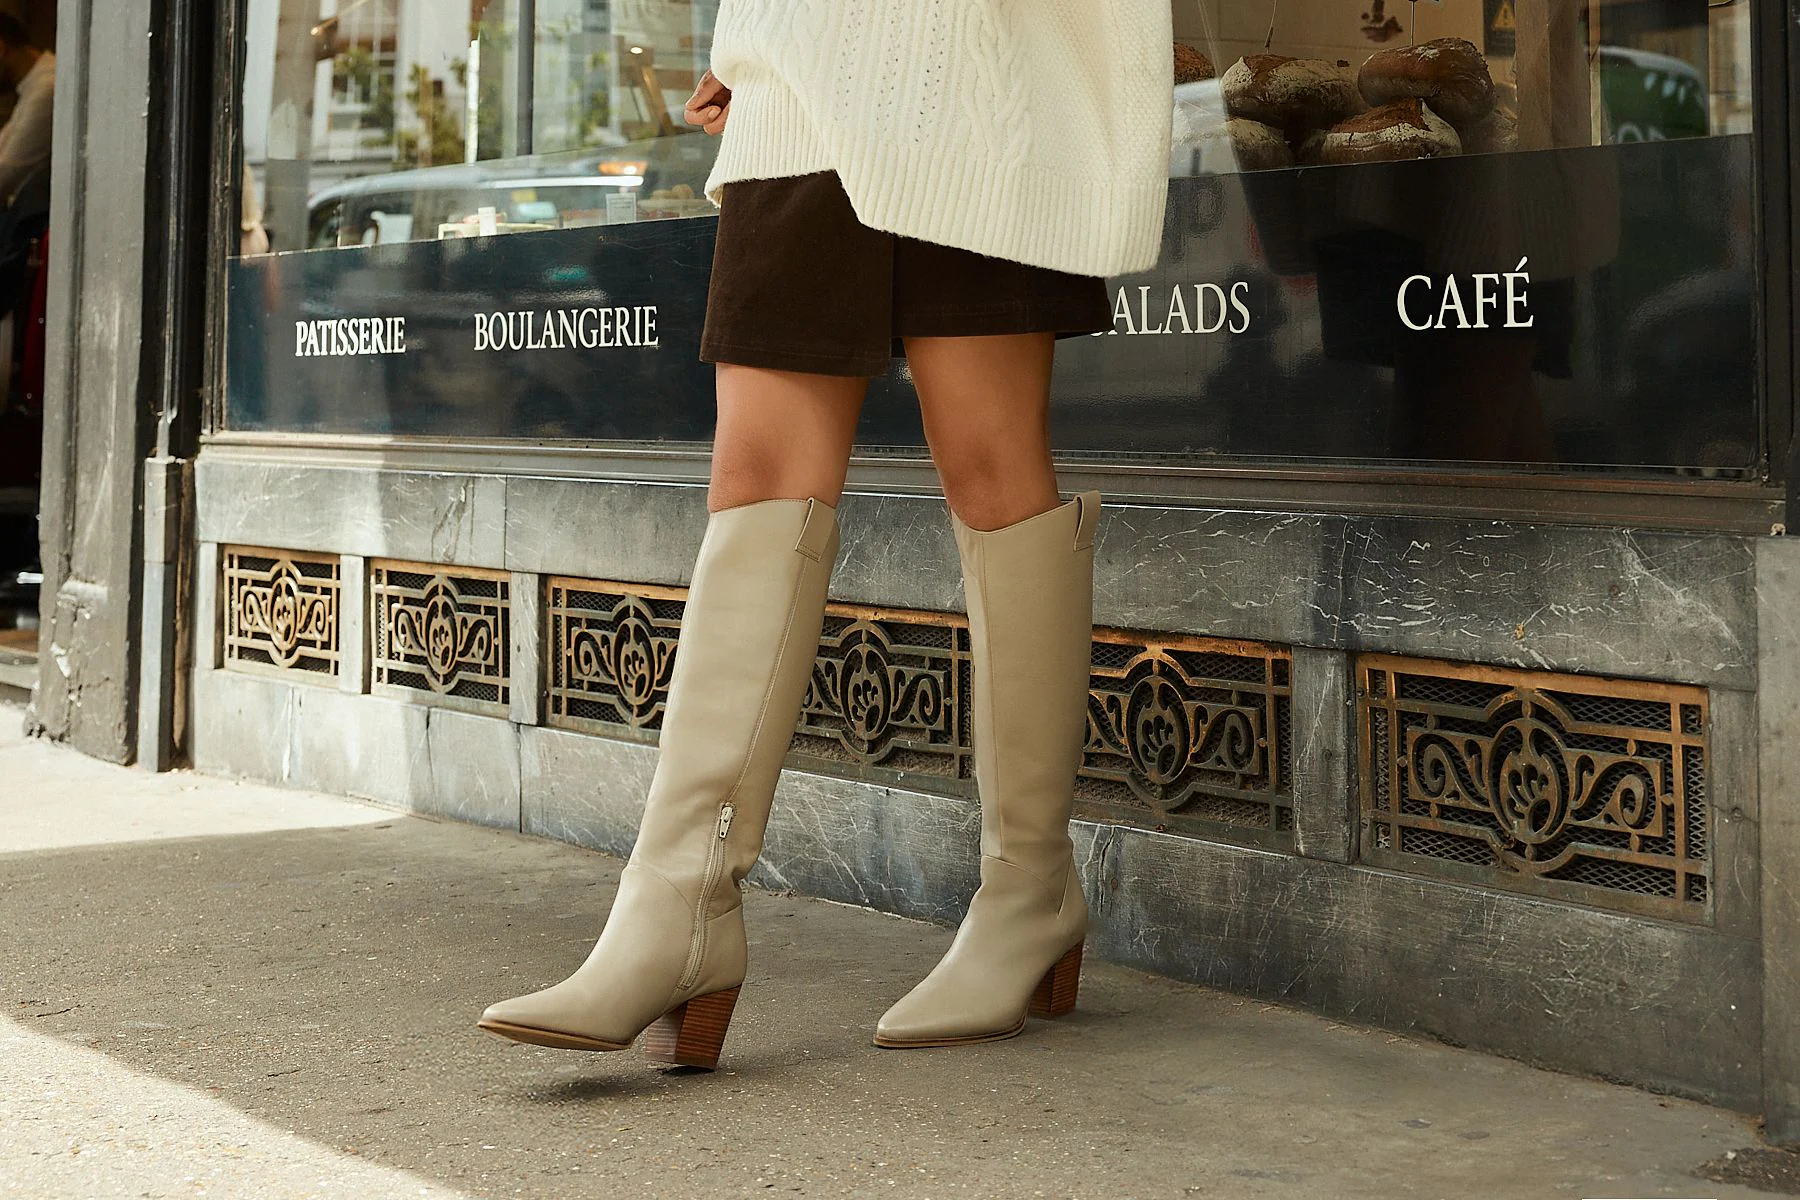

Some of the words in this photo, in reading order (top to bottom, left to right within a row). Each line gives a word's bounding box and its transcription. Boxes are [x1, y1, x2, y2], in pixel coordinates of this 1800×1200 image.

[1090, 281, 1251, 337] ALADS
[1396, 255, 1535, 331] CAFÉ
[295, 316, 406, 357] PATISSERIE
[474, 305, 659, 351] BOULANGERIE
